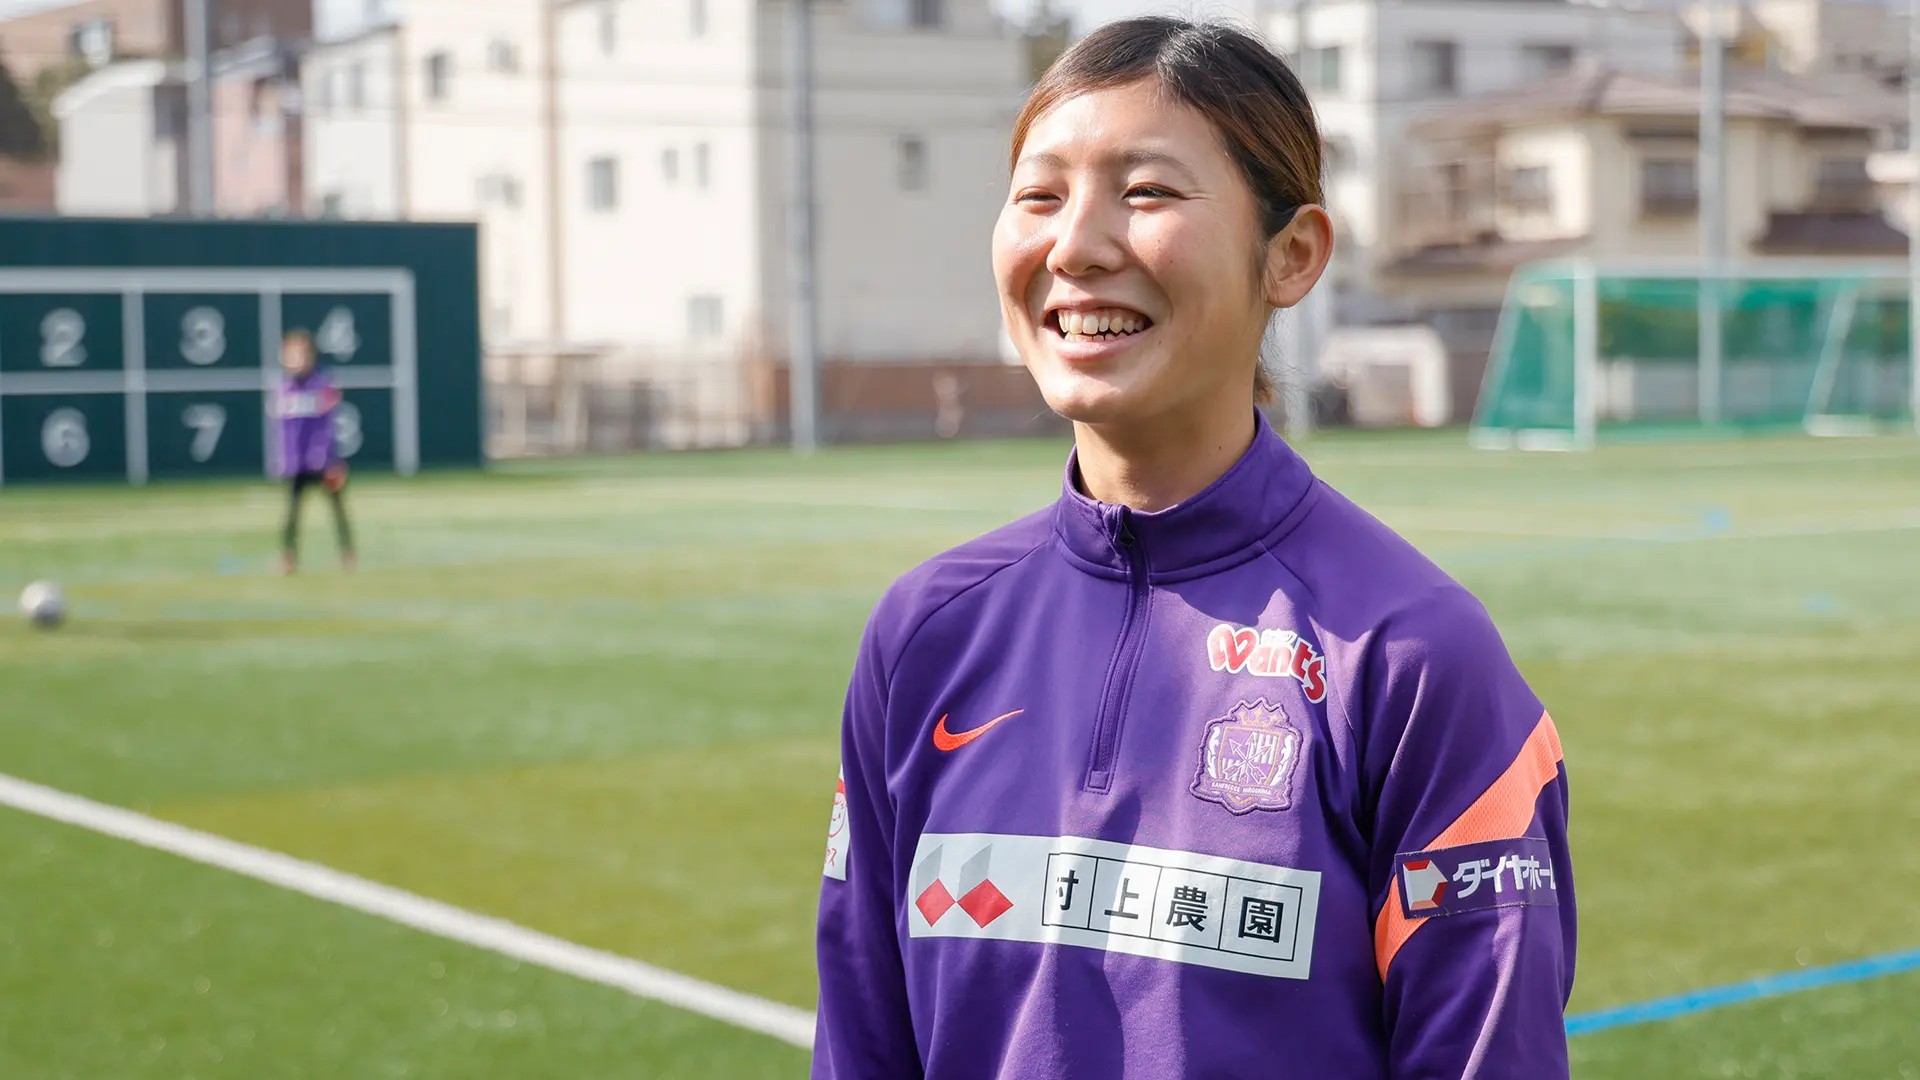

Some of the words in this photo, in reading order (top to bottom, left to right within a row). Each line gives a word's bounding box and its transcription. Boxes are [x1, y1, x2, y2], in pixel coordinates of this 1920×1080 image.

[40, 307, 87, 367] 2
[179, 305, 227, 365] 3
[317, 305, 361, 363] 4
[41, 407, 90, 468] 6
[181, 403, 227, 463] 7
